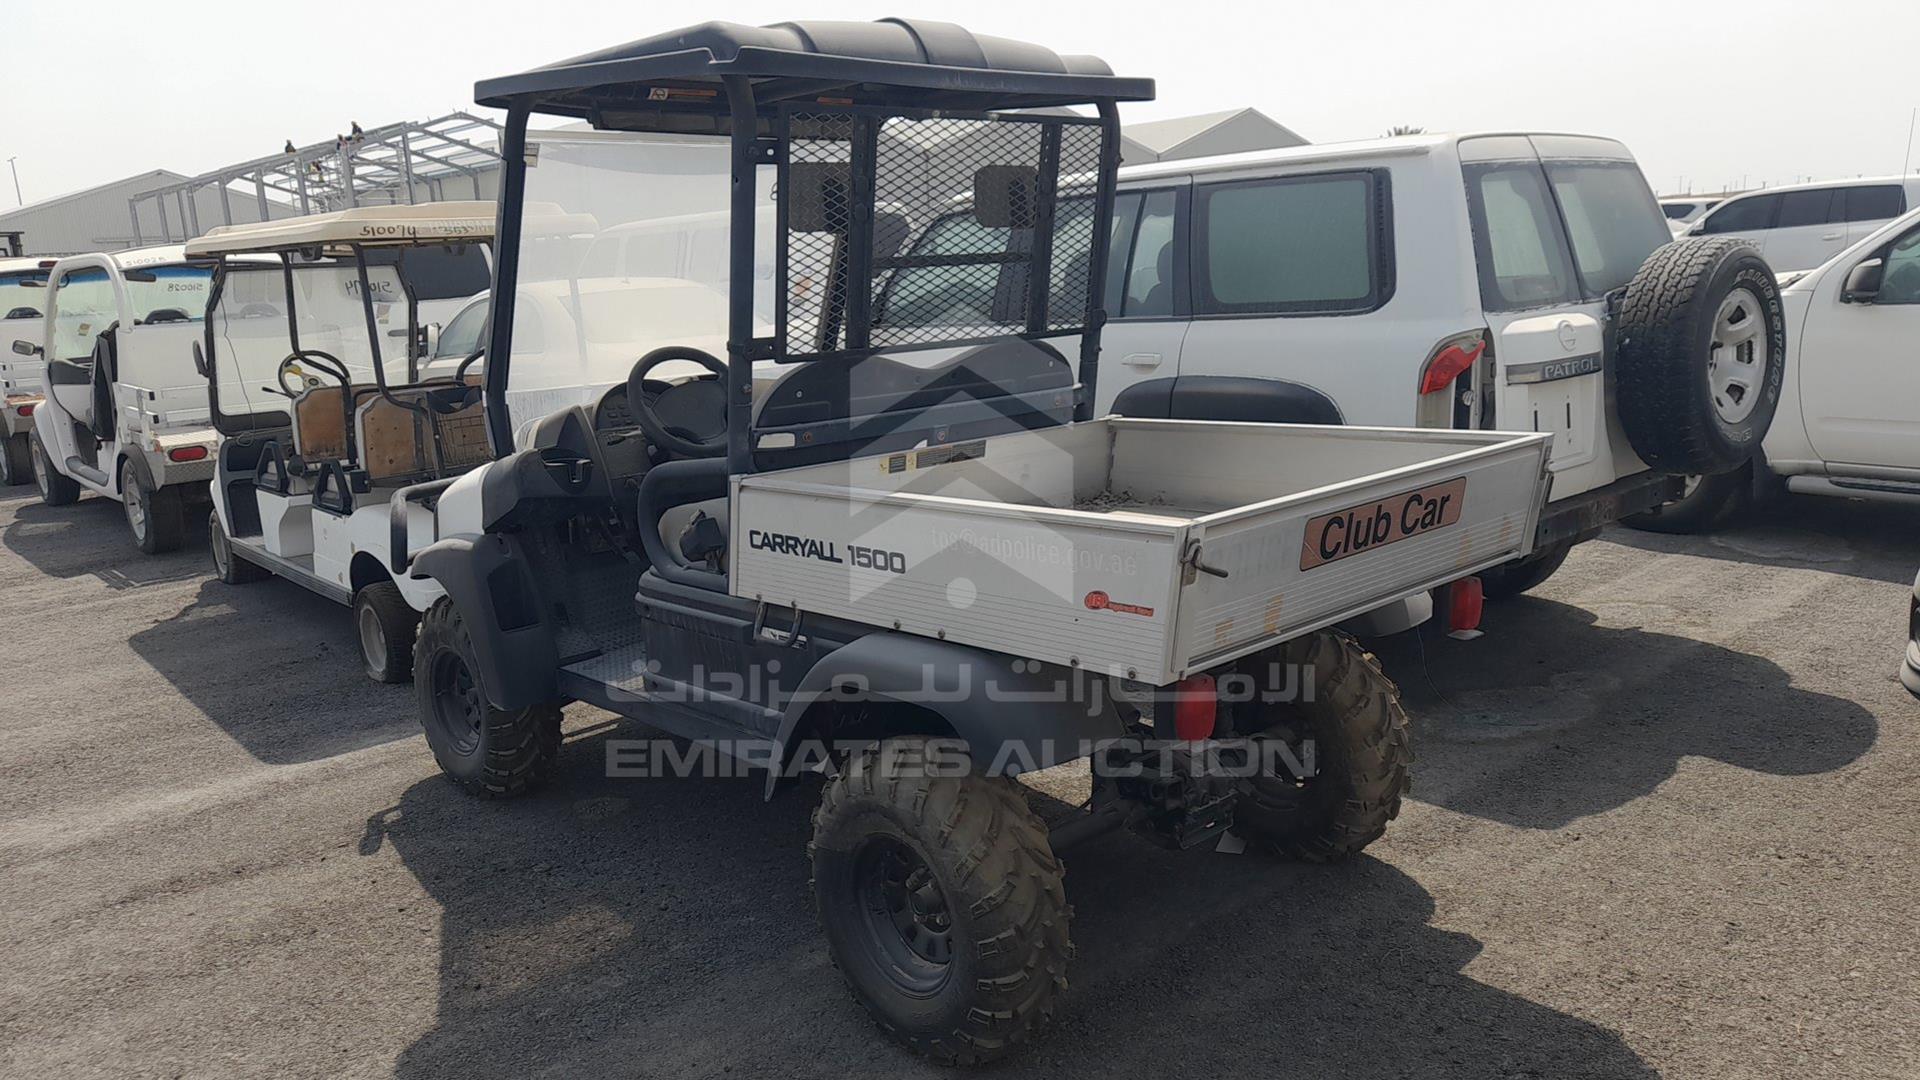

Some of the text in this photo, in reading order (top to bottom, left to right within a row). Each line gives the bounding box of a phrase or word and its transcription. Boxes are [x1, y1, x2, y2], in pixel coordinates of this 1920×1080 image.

[1544, 358, 1599, 378] PATROL
[1319, 504, 1391, 559] Club
[1400, 493, 1451, 535] Car
[749, 530, 906, 574] CARRYALL 1500
